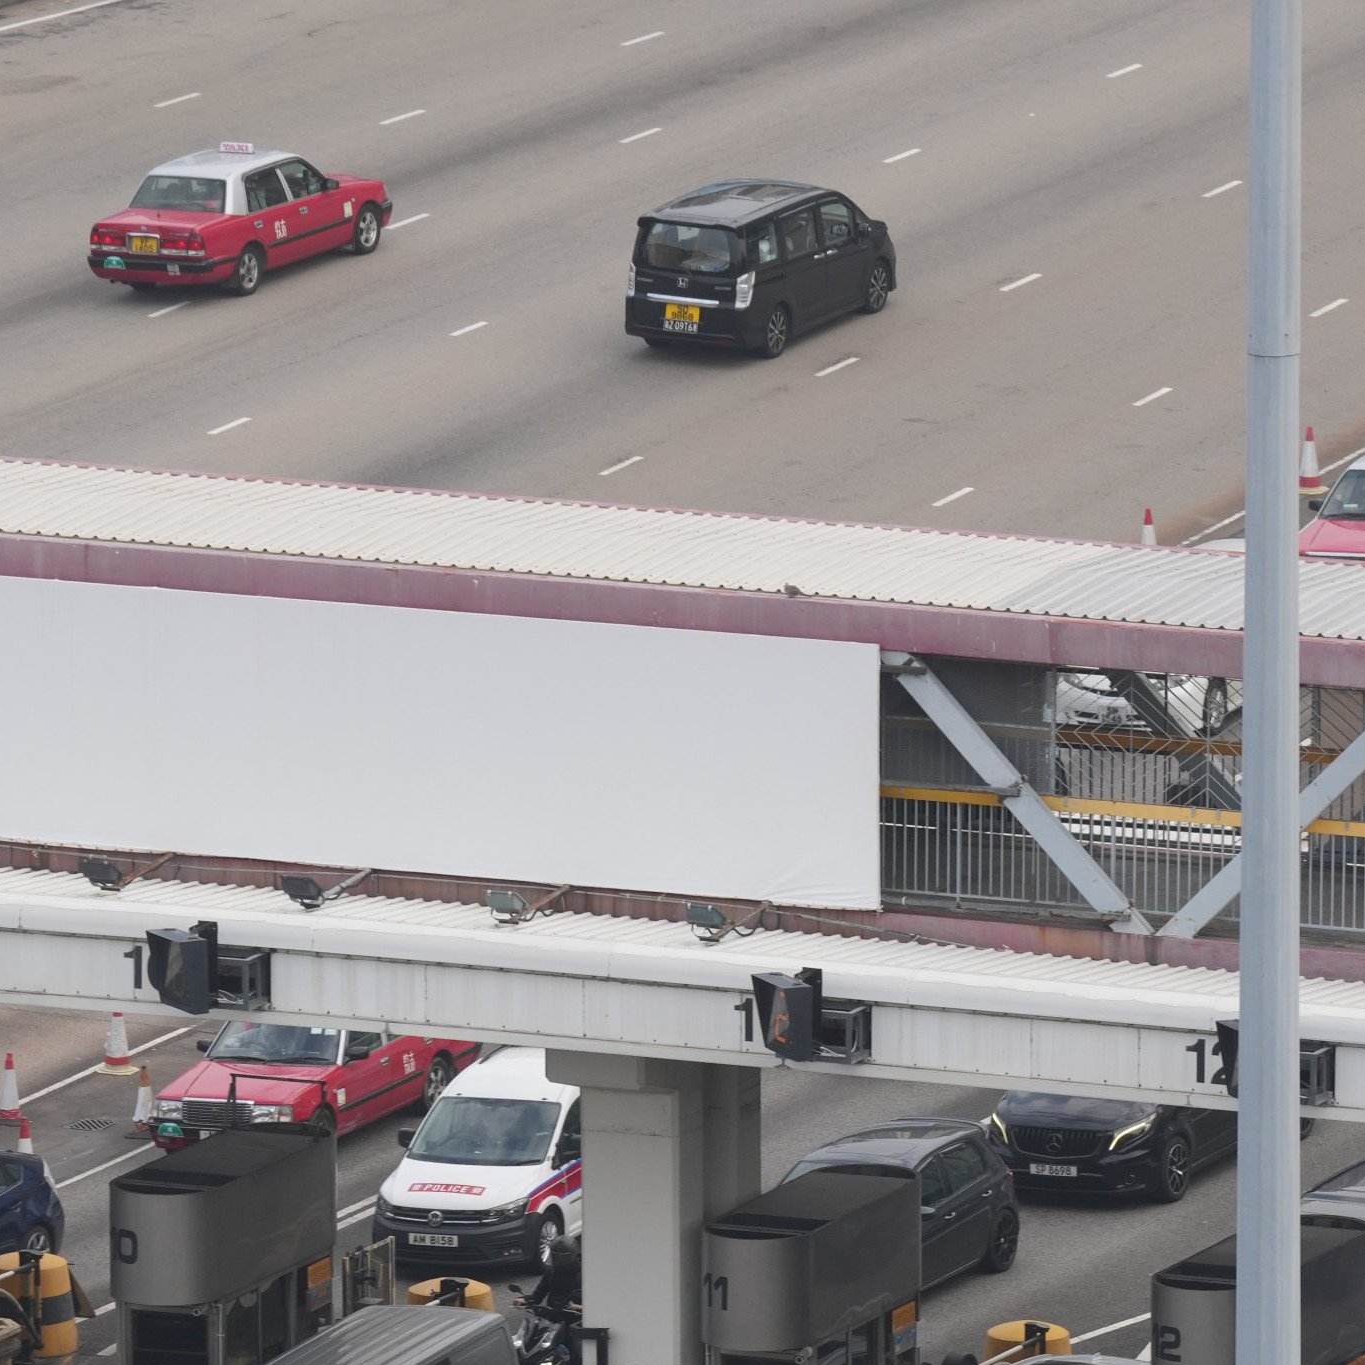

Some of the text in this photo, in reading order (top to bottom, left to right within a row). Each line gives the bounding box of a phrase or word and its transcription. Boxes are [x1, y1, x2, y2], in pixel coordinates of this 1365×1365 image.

[1049, 1165, 1072, 1176] 8698
[426, 1184, 468, 1193] POLICE
[412, 1234, 453, 1246] AM 8158
[704, 1273, 728, 1311] 11
[1154, 1323, 1182, 1363] 12
